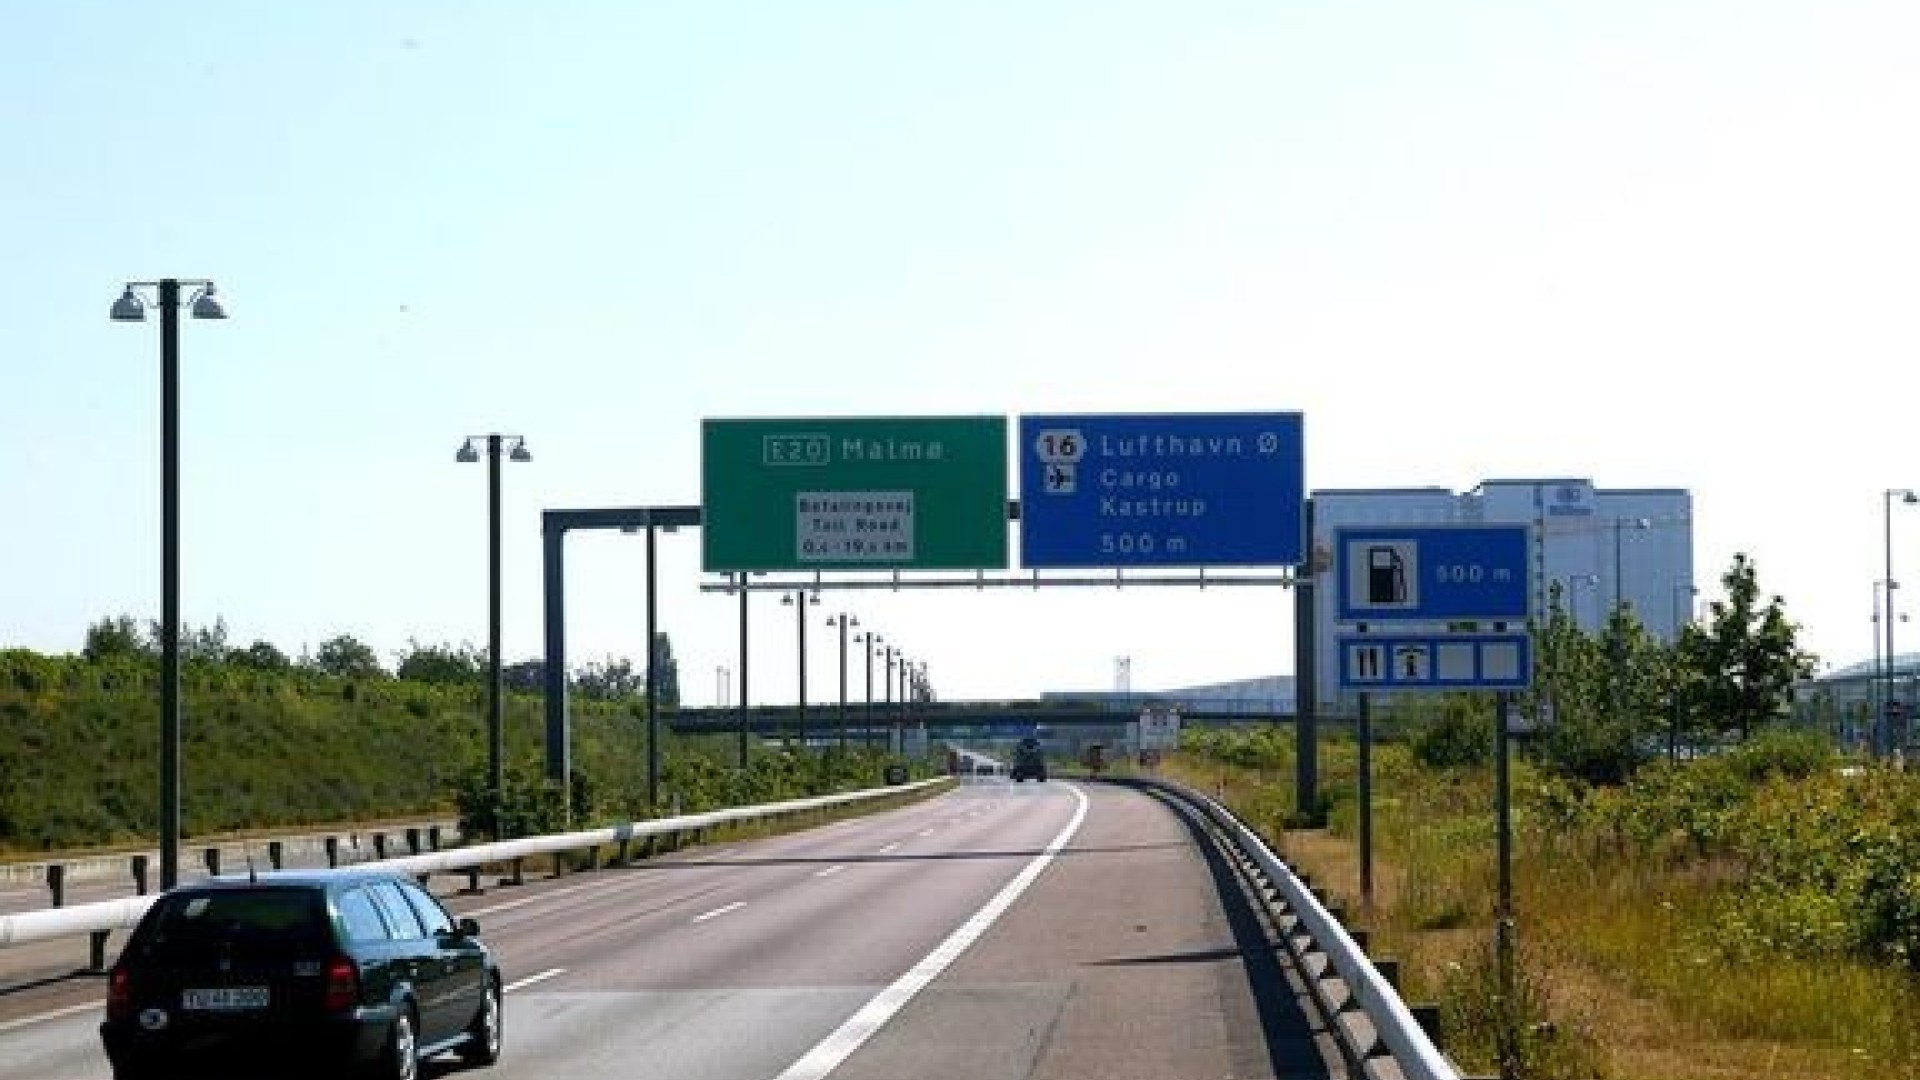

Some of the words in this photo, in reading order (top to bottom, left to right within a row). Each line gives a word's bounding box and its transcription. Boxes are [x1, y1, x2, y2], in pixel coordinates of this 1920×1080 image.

[771, 441, 822, 461] E20
[1043, 434, 1077, 457] 16
[1101, 433, 1242, 456] Lufthavn
[1101, 468, 1181, 490] Cargo
[1101, 498, 1208, 517] Kastrup
[1101, 531, 1154, 553] 500
[1166, 536, 1187, 551] m
[1436, 564, 1484, 583] 500
[1492, 567, 1511, 582] m
